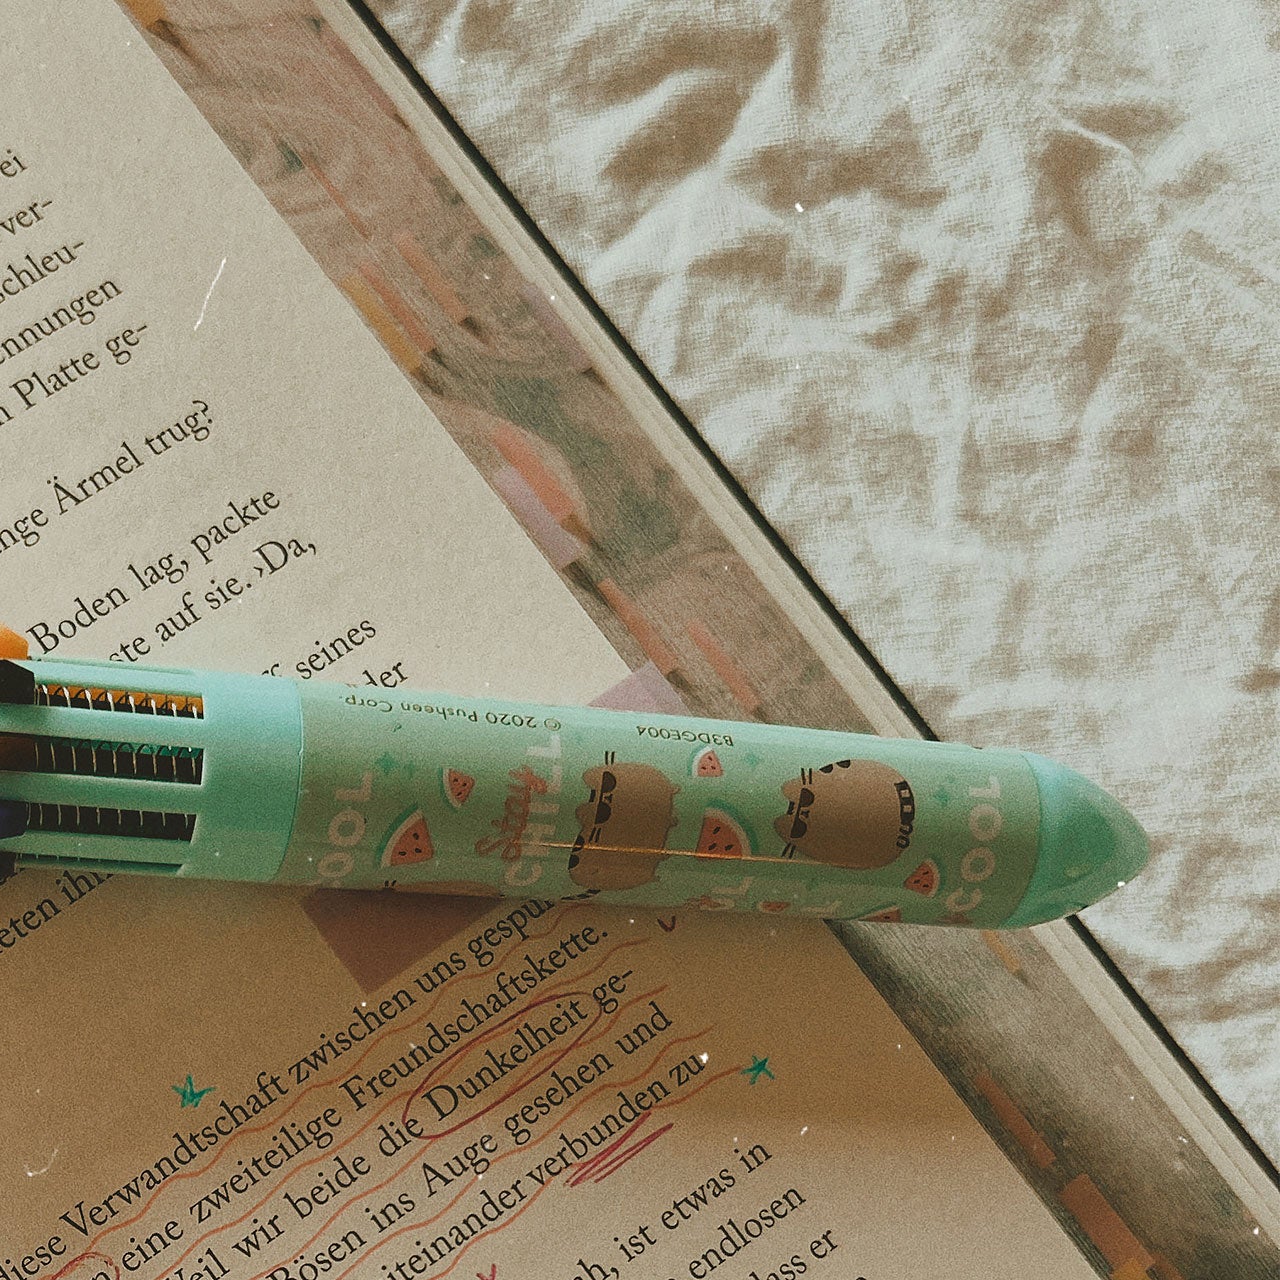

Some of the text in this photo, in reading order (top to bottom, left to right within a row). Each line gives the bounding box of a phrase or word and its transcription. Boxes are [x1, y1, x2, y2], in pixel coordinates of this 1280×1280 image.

[8, 352, 101, 411] Platte
[105, 324, 148, 366] ge-
[46, 440, 145, 516] Ärmel
[144, 399, 213, 456] trug?
[25, 491, 281, 663] Boden lag, packte
[204, 538, 317, 610] sie. ›Da,
[295, 619, 377, 680] seines
[338, 693, 394, 714] Corp.
[399, 700, 479, 724] Pusheen
[485, 710, 538, 730] 2020
[634, 722, 735, 749] B3DGE004
[316, 769, 373, 887] OOL
[473, 763, 550, 863] Stay
[503, 732, 564, 888] CHILL
[943, 774, 1005, 913] COOL
[58, 989, 418, 1237] Verwandtschaft zwischen
[188, 1107, 343, 1225] zweiteilige
[338, 926, 609, 1112] Freundschaftskette.
[282, 1155, 372, 1220] beide
[420, 1000, 589, 1122] Dunkelheit
[421, 1134, 499, 1199] Auge
[503, 1053, 615, 1146] gesehen
[688, 1188, 807, 1280] endlosen
